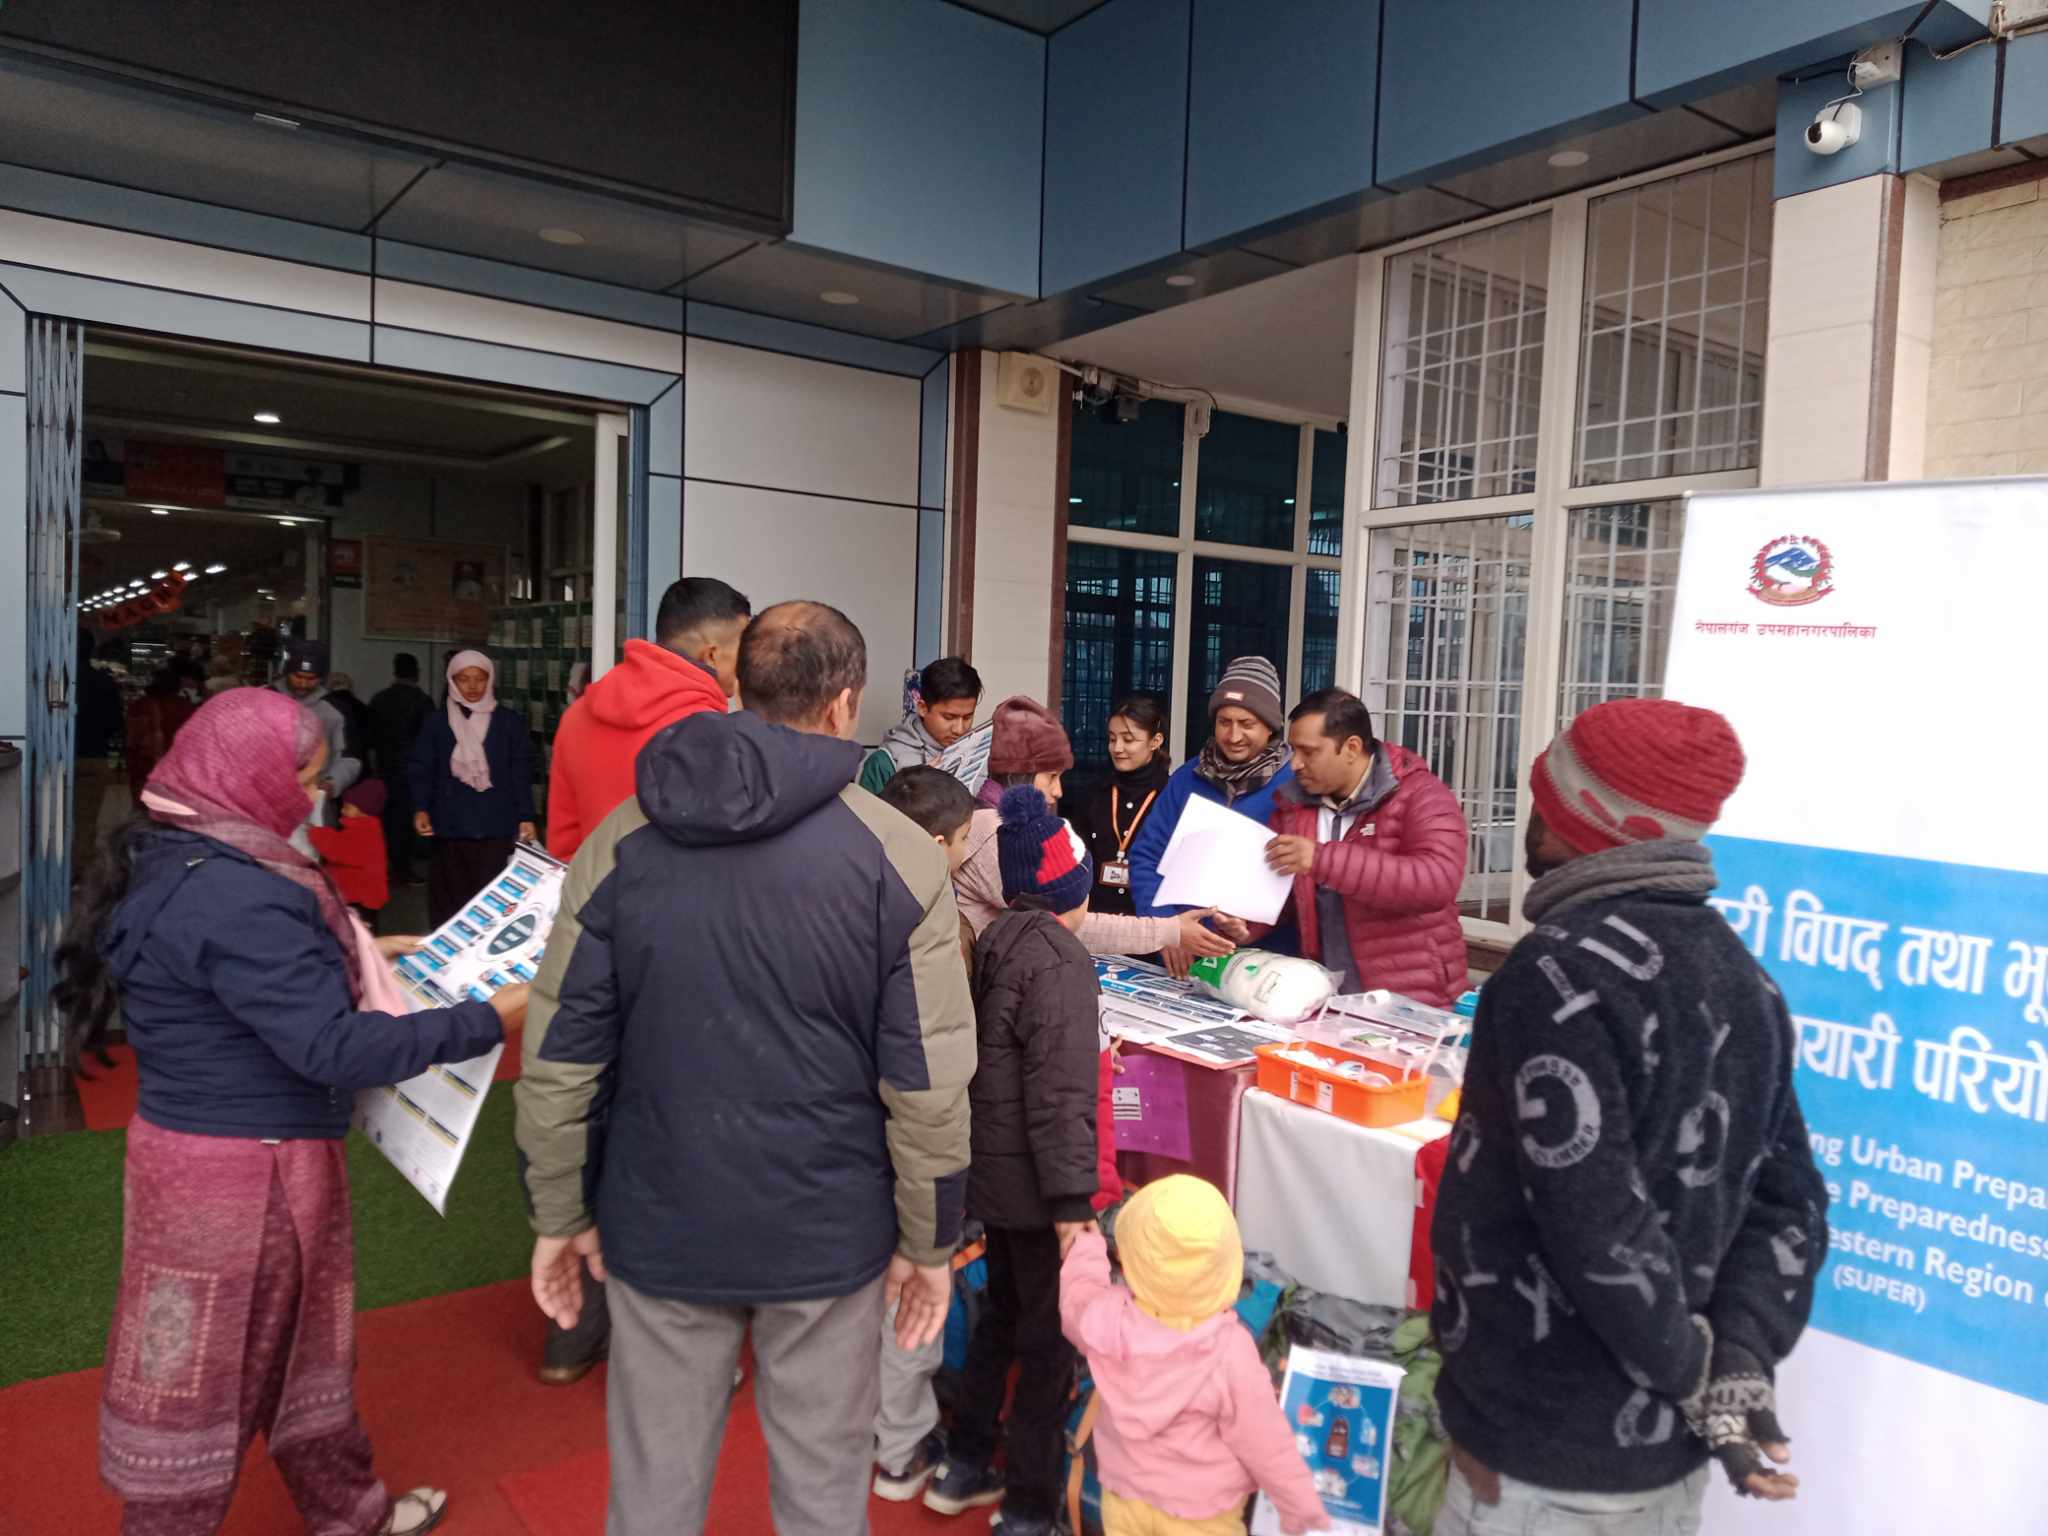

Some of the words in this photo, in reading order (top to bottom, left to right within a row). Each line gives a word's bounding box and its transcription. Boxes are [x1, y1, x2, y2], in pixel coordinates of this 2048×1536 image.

[1756, 622, 1877, 639] उपमहानगरपालिका
[1706, 885, 1773, 957] री
[1899, 926, 1993, 995] तथा
[2004, 940, 2048, 1025] भू
[1807, 1128, 1843, 1167] ng
[1851, 1134, 1943, 1185] Urban
[1828, 1225, 1916, 1271] estern
[1923, 1245, 2034, 1305] Region
[1833, 1263, 1928, 1314] (SUPER)
